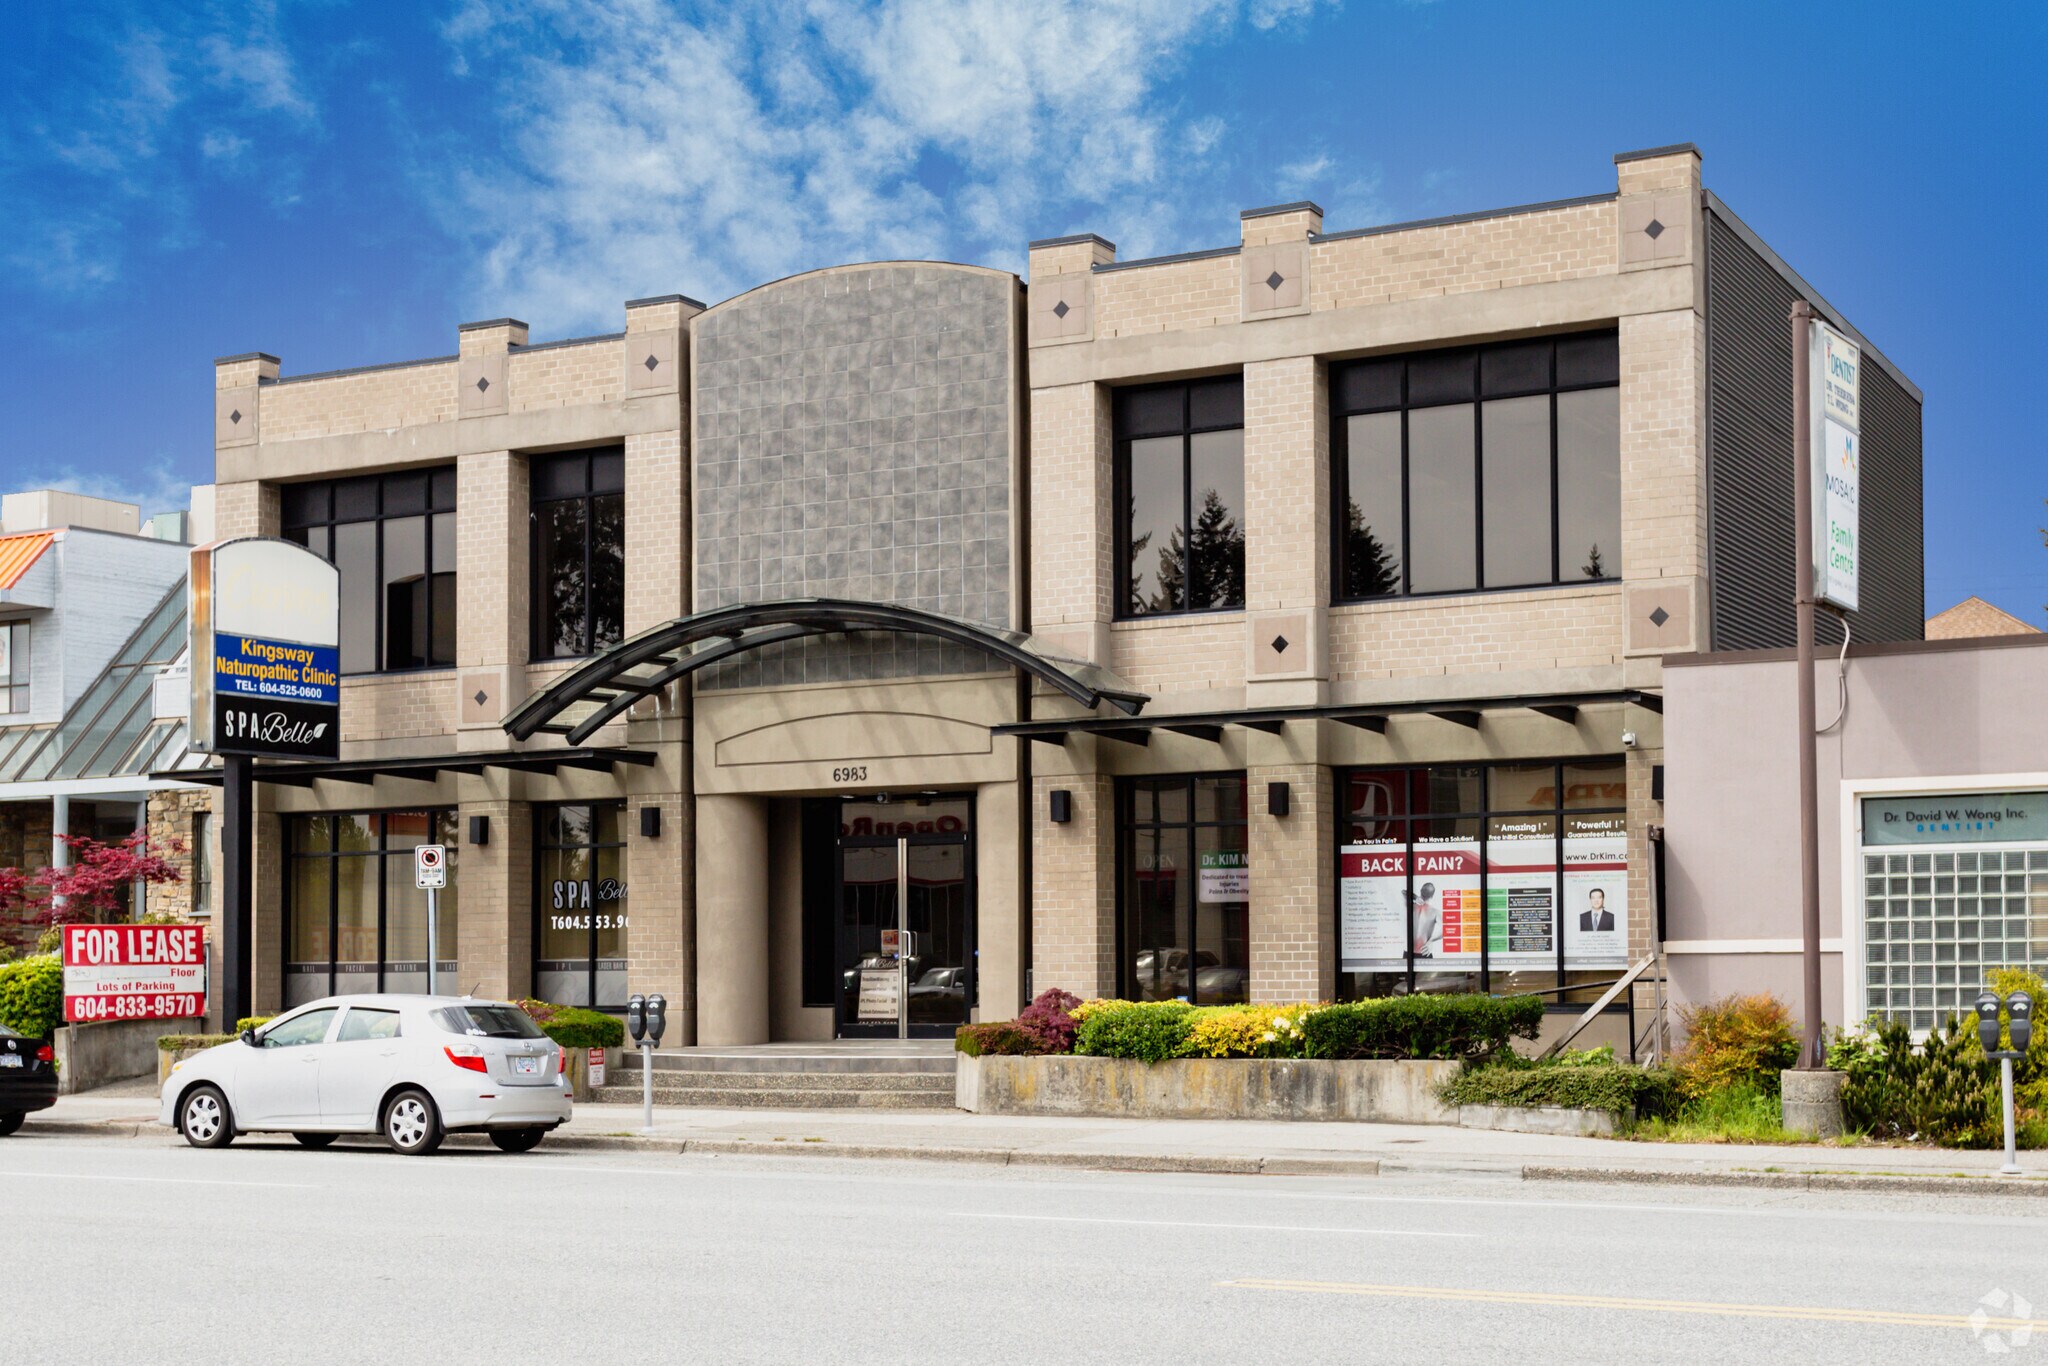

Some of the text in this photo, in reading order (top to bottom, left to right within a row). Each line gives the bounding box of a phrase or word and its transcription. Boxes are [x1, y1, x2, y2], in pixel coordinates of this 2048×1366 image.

[1831, 354, 1856, 386] DENTIST
[1826, 473, 1854, 503] MOSAIC
[1831, 520, 1854, 556] Family
[1830, 546, 1853, 576] Centre
[241, 638, 314, 666] Kingsway
[216, 656, 337, 686] Naturopathic Clinic
[235, 679, 322, 698] TEL: 604-525-0600
[225, 710, 315, 744] SPA Belle
[832, 766, 867, 782] 6983
[1577, 820, 1612, 829] Powerful
[1884, 808, 2028, 823] Dr. David W. Wong Inc.
[1501, 823, 1537, 832] Amazing
[1916, 821, 1994, 833] DENTIST
[1202, 854, 1216, 866] Dr.
[1218, 853, 1238, 866] KIM
[1361, 856, 1464, 873] BACK PAIN?
[553, 880, 591, 909] SPA
[71, 929, 197, 964] FOR LEASE
[170, 968, 196, 977] Floor
[394, 964, 417, 972] WAXING
[96, 981, 176, 992] Lots of Parking
[74, 995, 197, 1019] 604-833-9570
